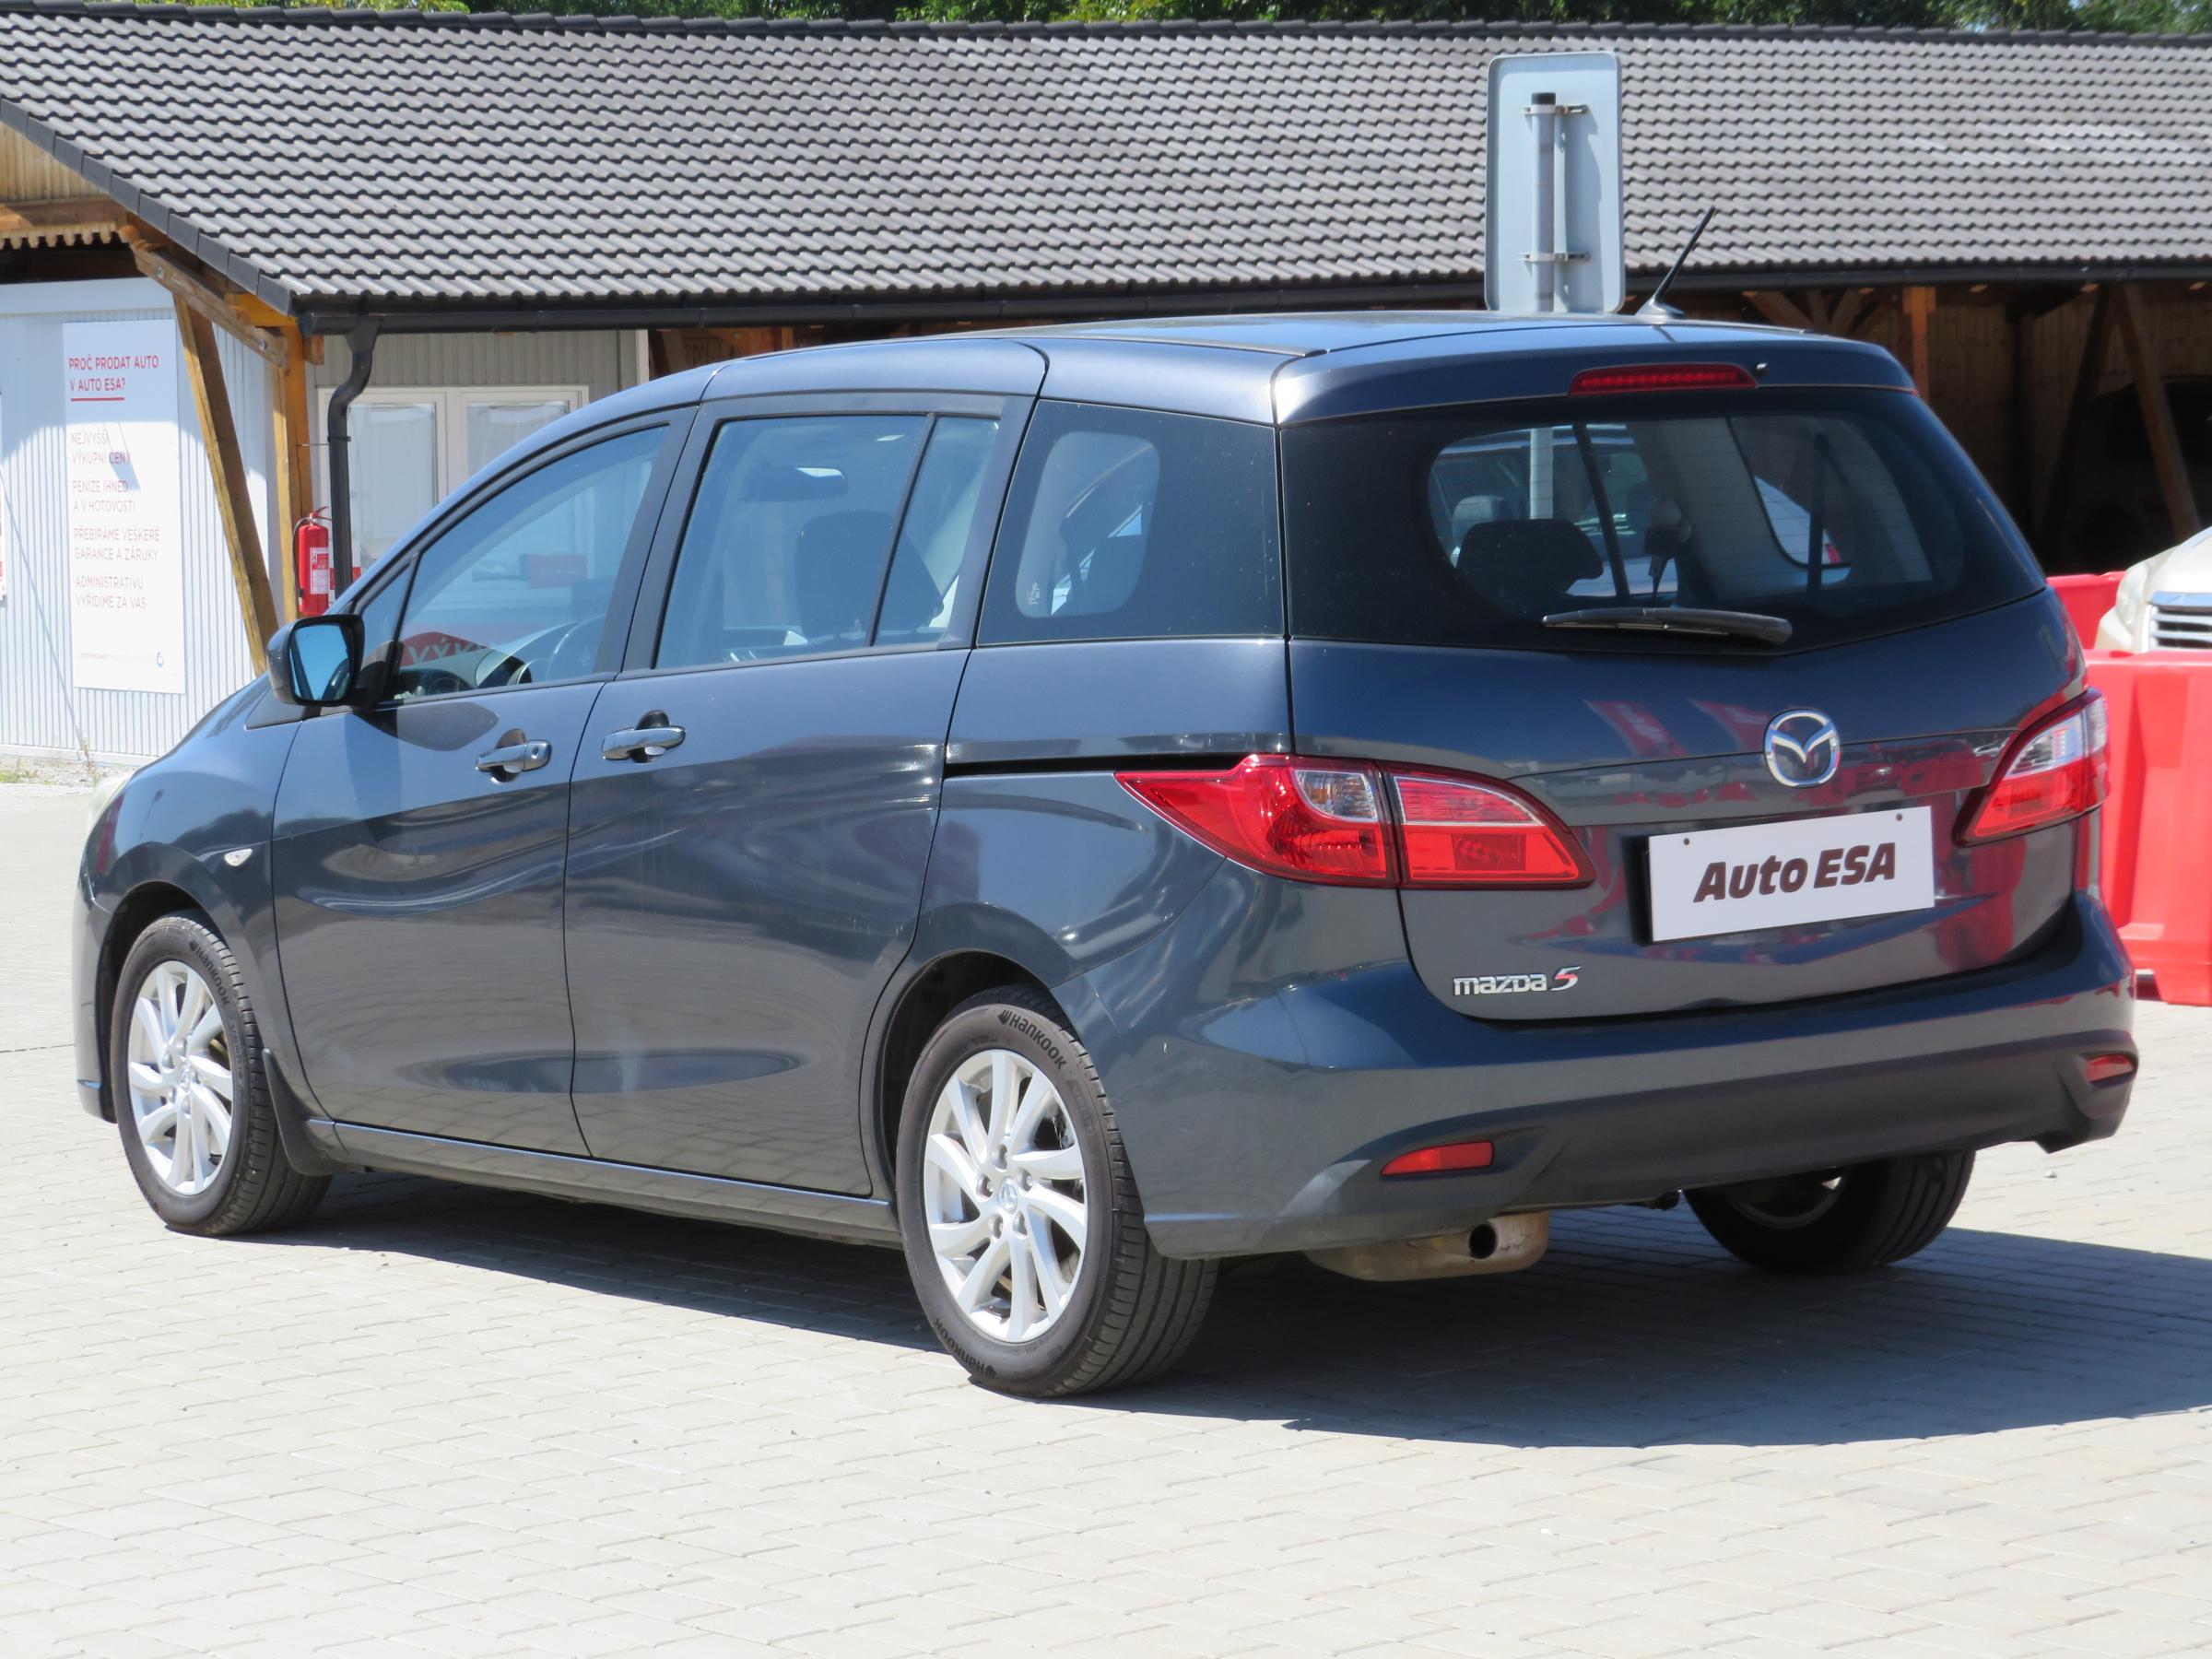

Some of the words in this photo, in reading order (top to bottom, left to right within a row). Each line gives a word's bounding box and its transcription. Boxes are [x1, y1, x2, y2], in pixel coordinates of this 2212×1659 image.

[68, 354, 92, 371] PROČ
[95, 356, 131, 370] PRODAT
[134, 355, 159, 369] AUTO
[69, 378, 76, 392] V
[78, 378, 100, 392] AUTO
[104, 377, 126, 391] ESA?
[109, 452, 131, 465] CENY
[103, 479, 129, 493] IHNED
[74, 500, 79, 512] A
[81, 500, 87, 512] V
[88, 500, 135, 512] HOTOVOSTI
[122, 525, 160, 542] VEŠKERÉ
[74, 547, 114, 561] GARANCE
[124, 546, 159, 561] ZÁRUKY
[75, 575, 144, 590] ADMINISTRATIVU
[116, 595, 127, 608] ZA
[1692, 855, 1808, 903] Auto
[1813, 841, 1896, 888] ESA
[1453, 973, 1548, 996] mazda
